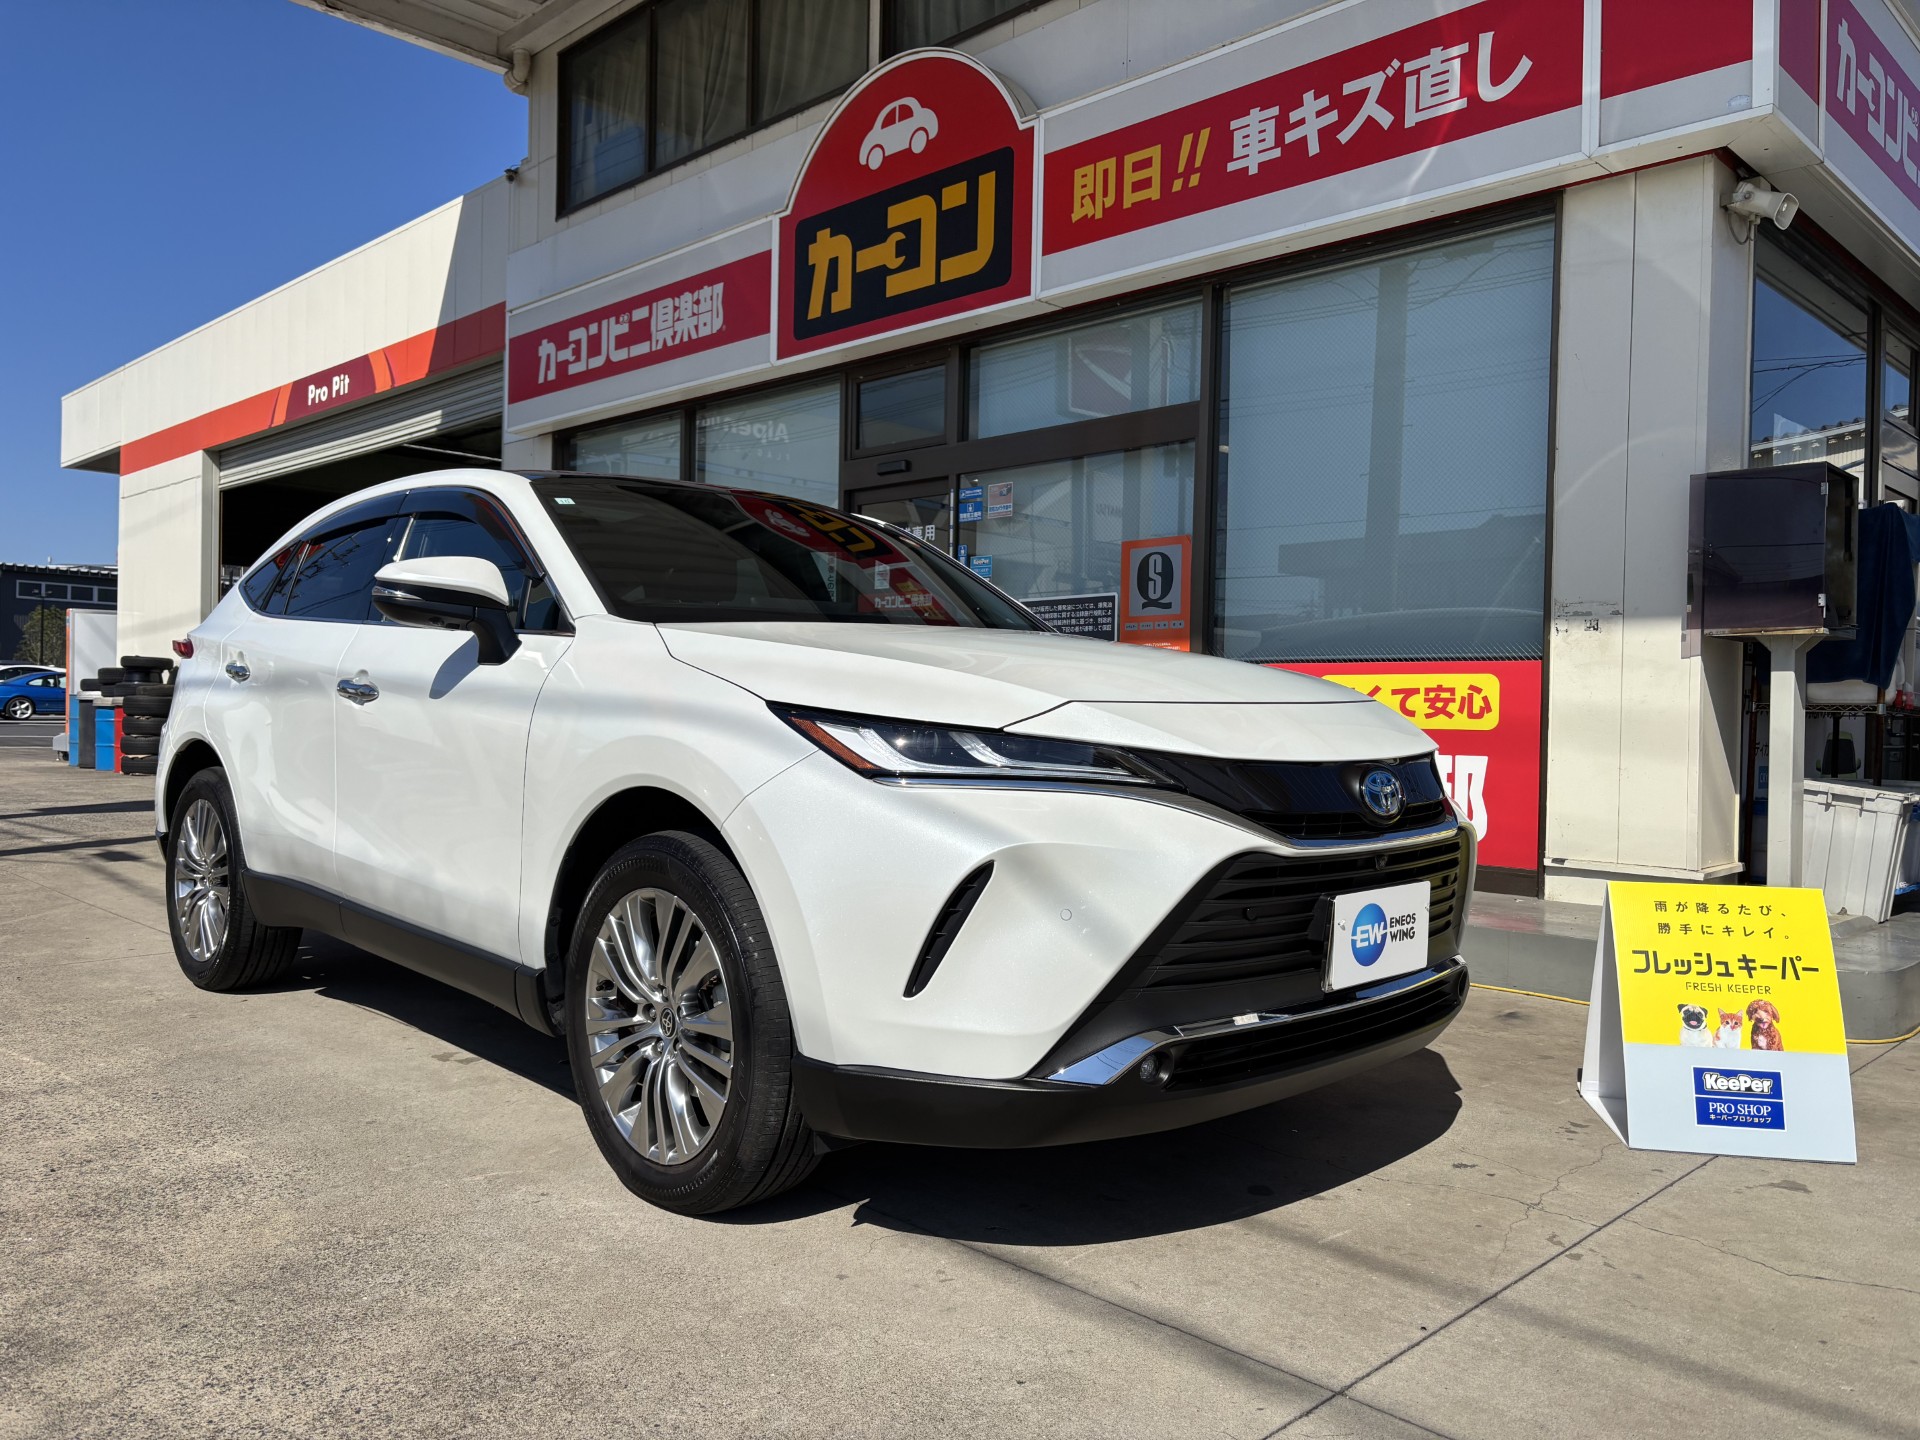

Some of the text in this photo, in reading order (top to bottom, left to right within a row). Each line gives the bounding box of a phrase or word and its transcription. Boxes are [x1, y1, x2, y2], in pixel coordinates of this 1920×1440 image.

[1226, 31, 1534, 176] 車キズ直し
[806, 170, 996, 321] カーコン
[537, 281, 725, 384] カーコンビニ倶楽部
[307, 373, 350, 406] Pro Pit
[1654, 899, 1787, 918] 雨が降るたび、
[1389, 912, 1417, 929] ENEOS
[1389, 928, 1416, 943] WING
[1657, 922, 1790, 941] 勝手にキレイ。
[1631, 949, 1820, 981] フレッシュキーパー
[1685, 981, 1772, 995] FRESH KEEPER
[1703, 1072, 1773, 1094] KeePer
[1708, 1101, 1772, 1116] PRO SHOP
